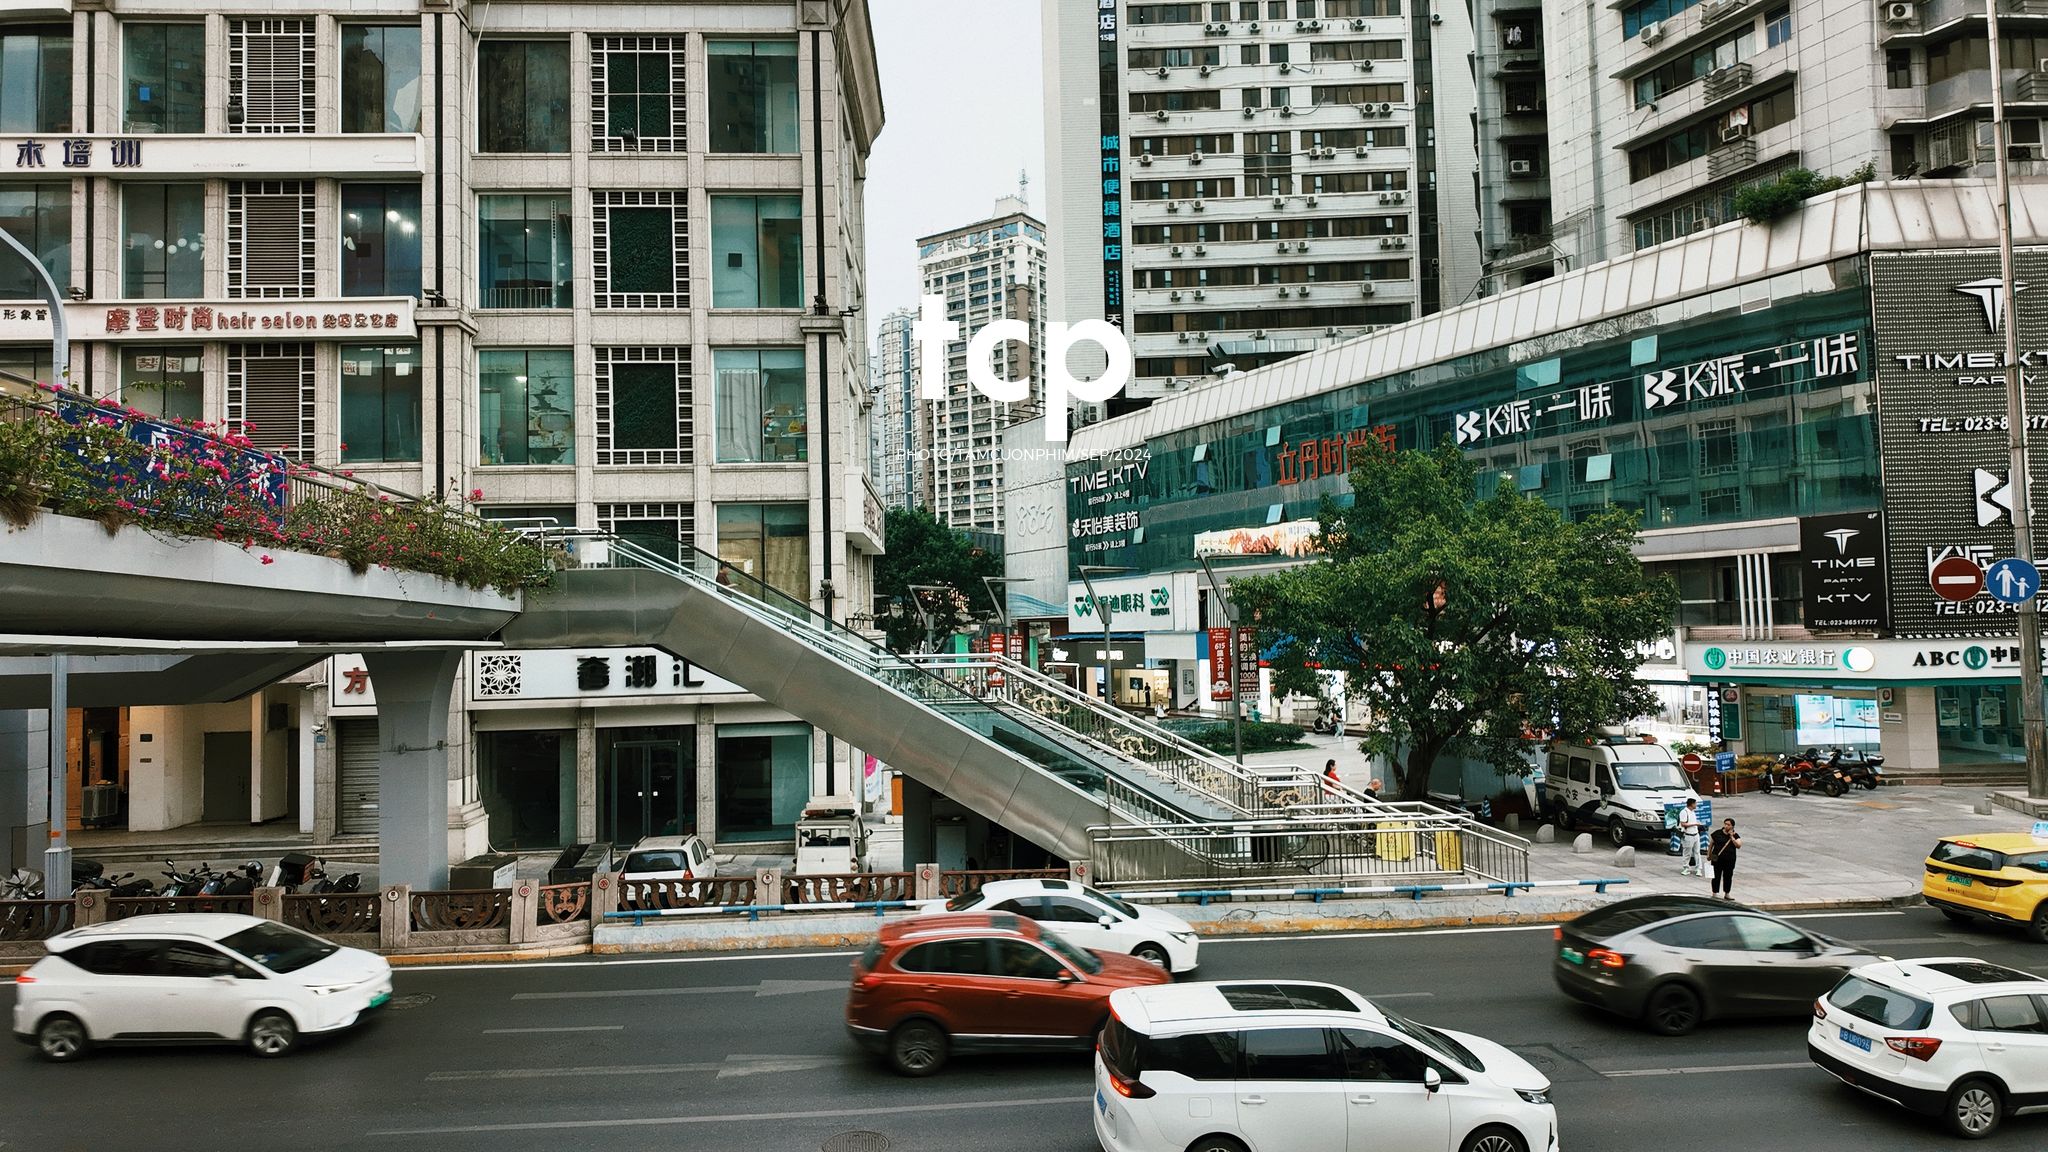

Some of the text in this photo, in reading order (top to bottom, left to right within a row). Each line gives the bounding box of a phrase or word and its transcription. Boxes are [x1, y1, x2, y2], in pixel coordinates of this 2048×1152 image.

[1102, 135, 1121, 260] 城市便捷酒店
[106, 306, 213, 333] 摩登时尚
[217, 312, 256, 330] hair
[261, 312, 318, 330] salon
[1958, 374, 2037, 385] PARY
[1070, 460, 1149, 494] TIME.KTV
[1080, 510, 1139, 537] 天怡美装饰
[1811, 557, 1876, 569] TIME
[1817, 593, 1871, 603] KTV
[1216, 650, 1225, 679] 盛大开业
[1728, 648, 1836, 665] 中国农业银行
[1912, 650, 1960, 666] ABC
[343, 666, 369, 694] 方
[1565, 787, 1579, 801] 公安
